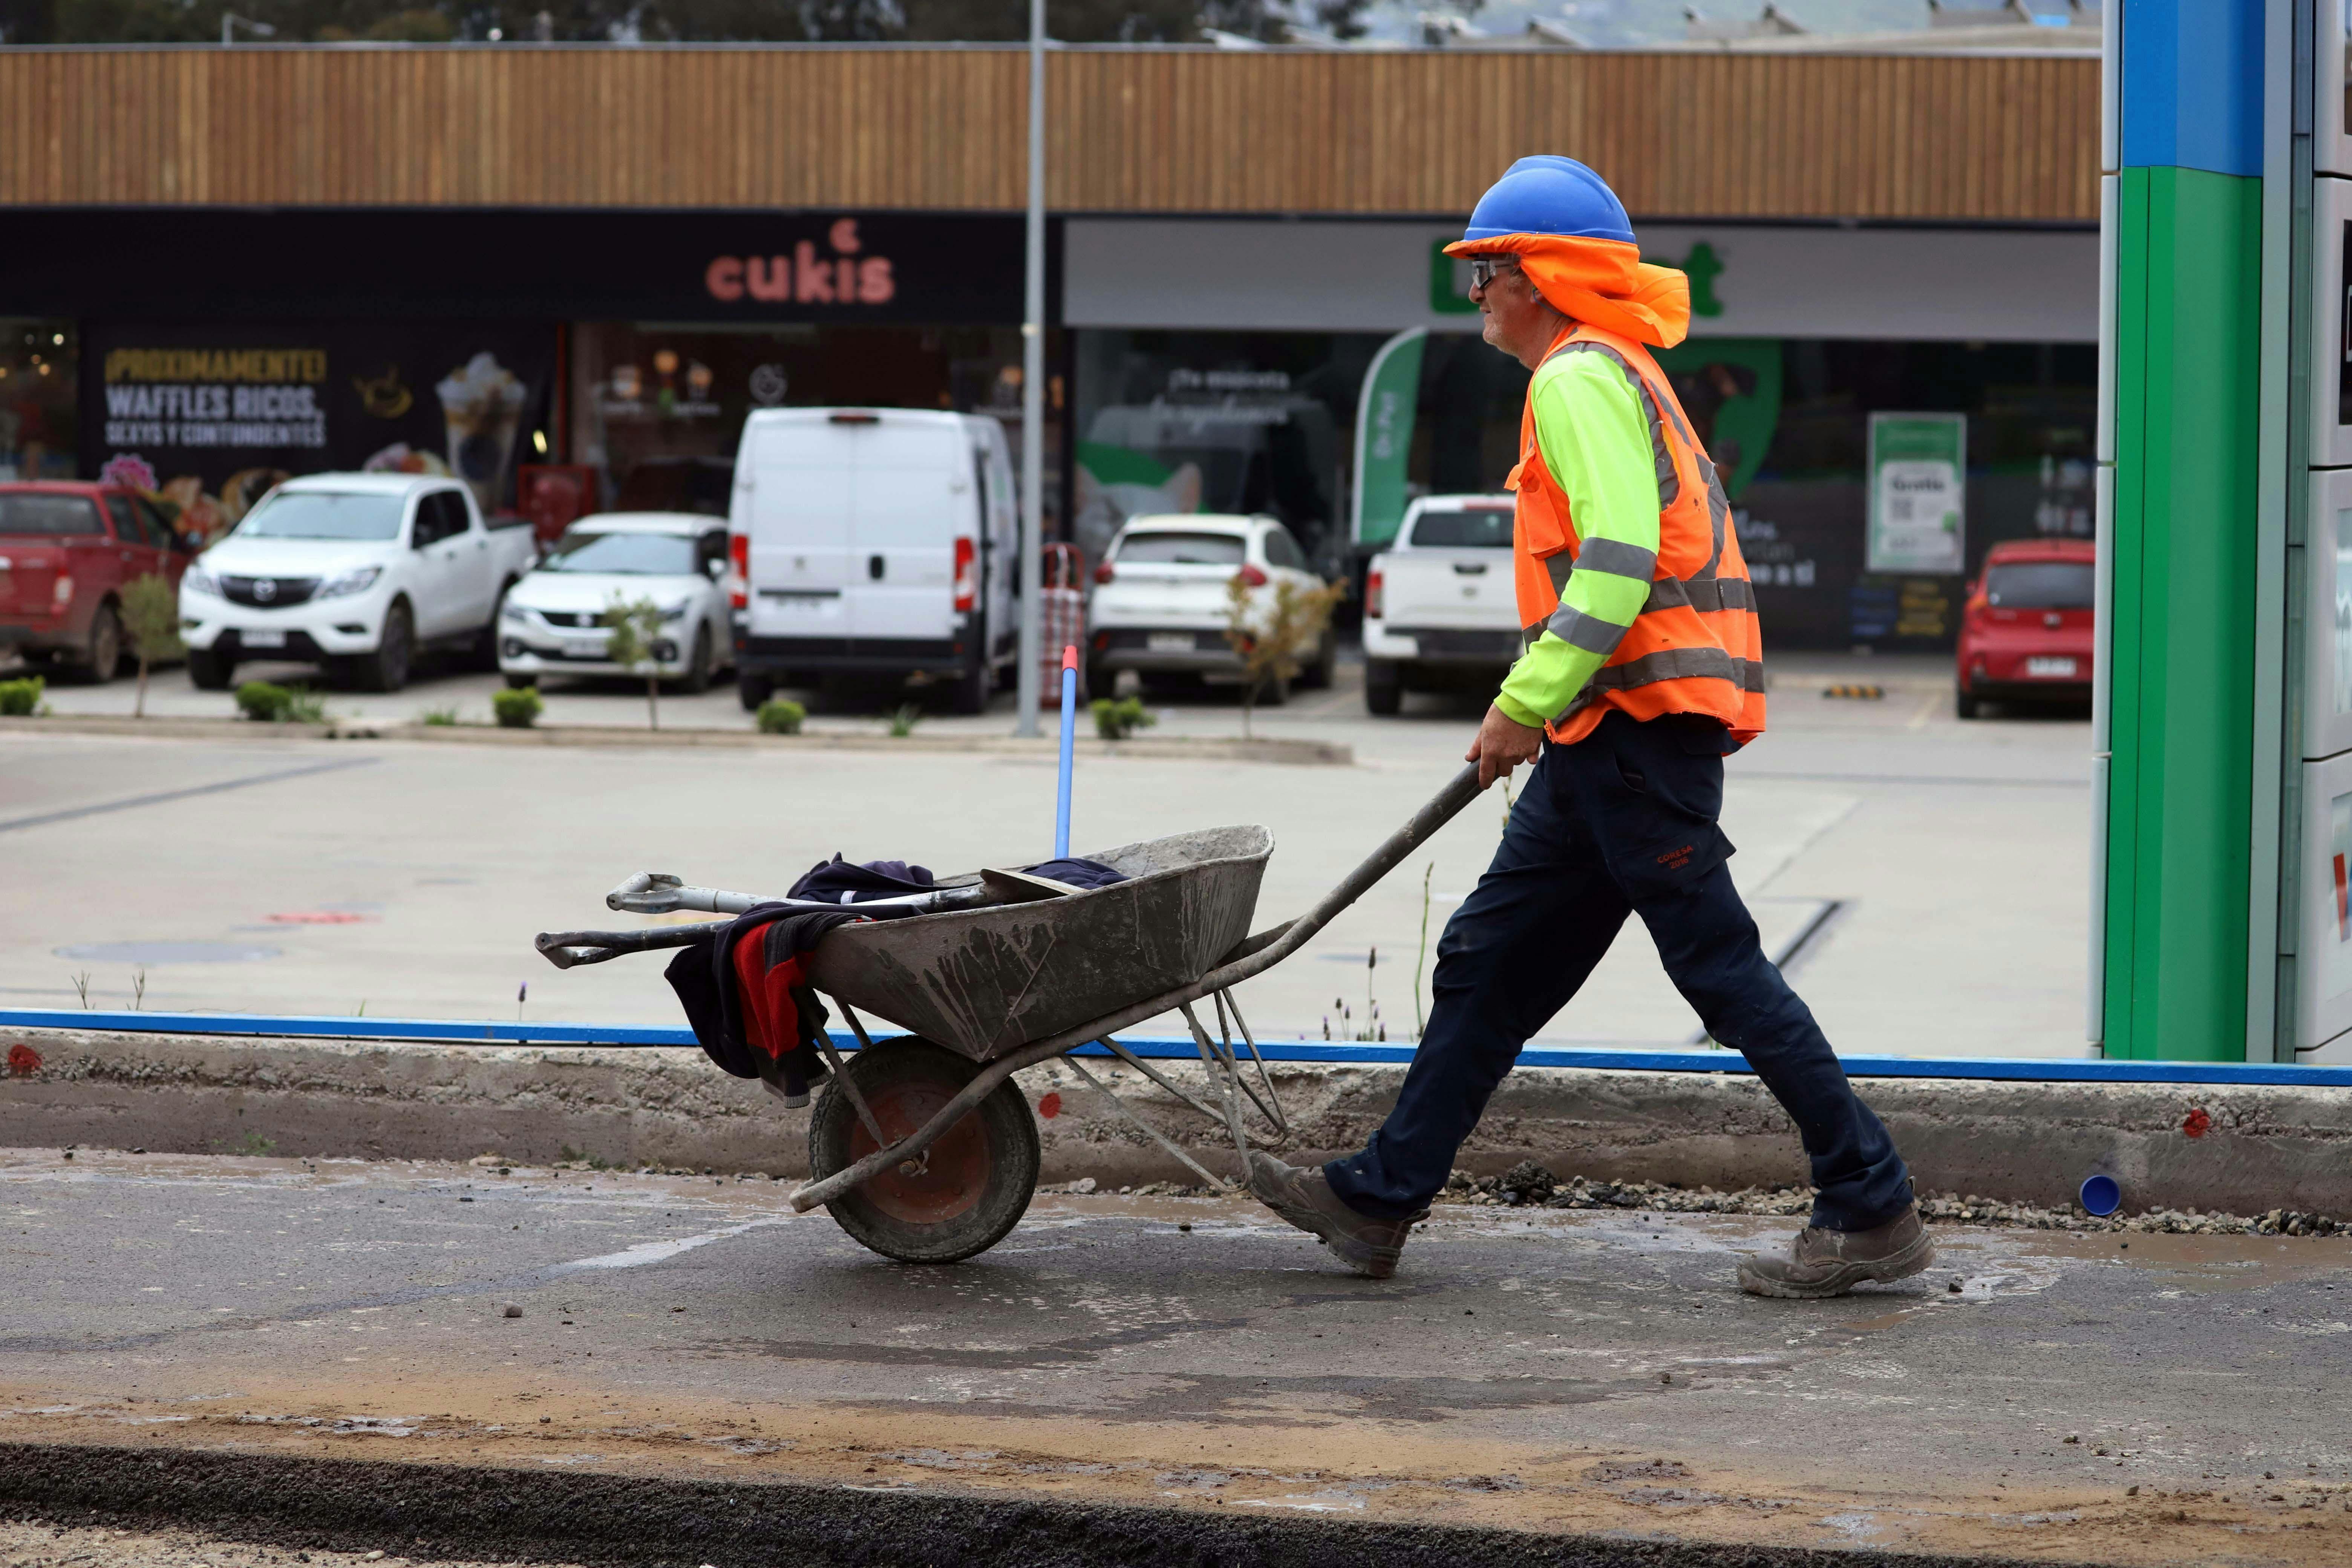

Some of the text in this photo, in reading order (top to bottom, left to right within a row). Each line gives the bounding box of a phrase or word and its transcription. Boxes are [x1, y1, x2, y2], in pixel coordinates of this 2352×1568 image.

[706, 218, 895, 302] cukis
[105, 384, 227, 418] WAFFLES
[105, 420, 326, 446] SEXYS Y CONTUNDENTES
[1657, 844, 1693, 863] CORESA
[1670, 857, 1689, 869] 2016
